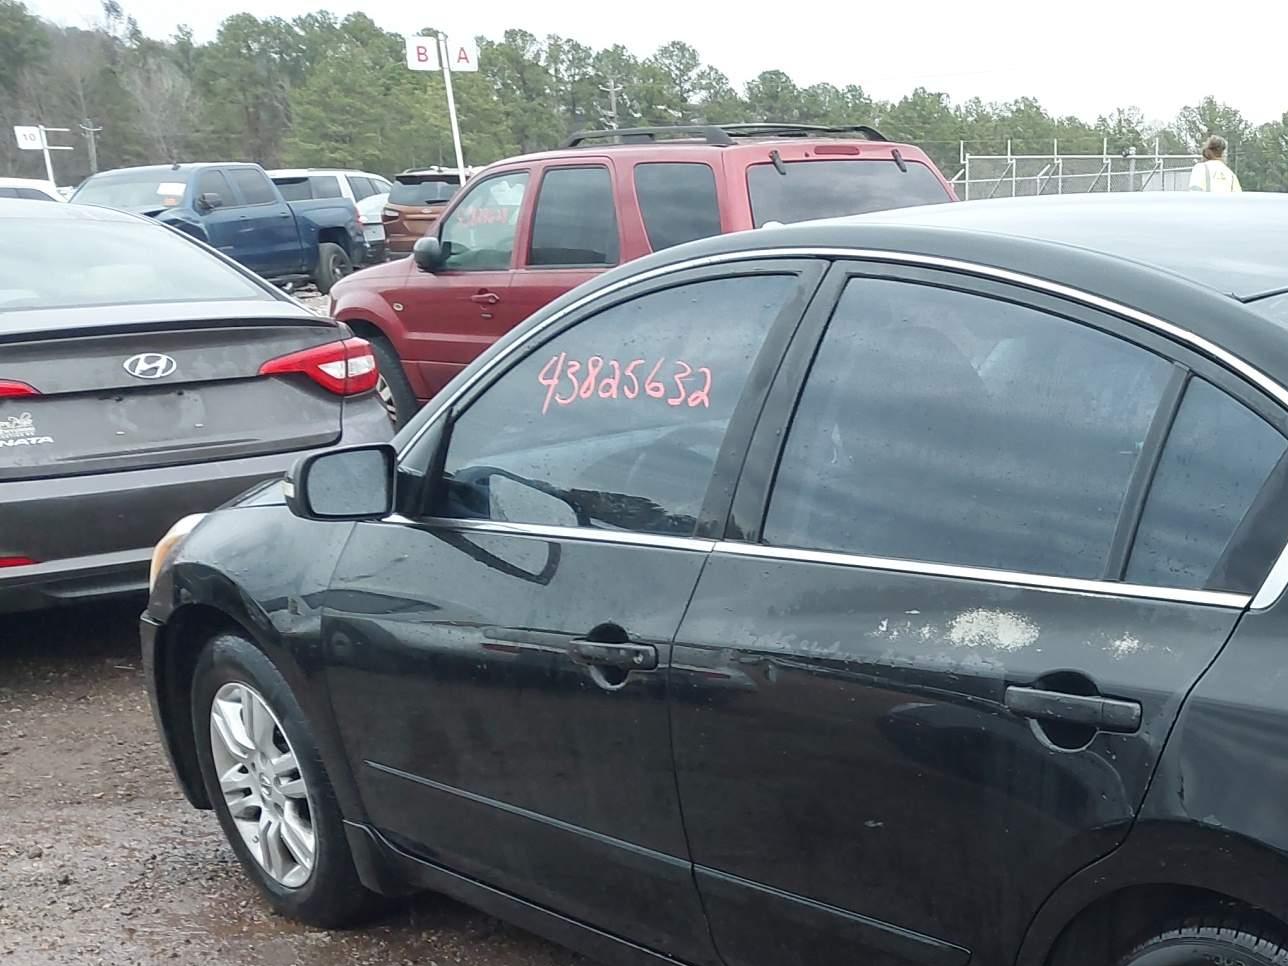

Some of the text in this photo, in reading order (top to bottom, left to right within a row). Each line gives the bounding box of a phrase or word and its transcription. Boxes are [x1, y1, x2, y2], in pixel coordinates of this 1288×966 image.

[416, 45, 428, 62] B
[457, 47, 470, 63] A
[538, 352, 712, 415] 43825632
